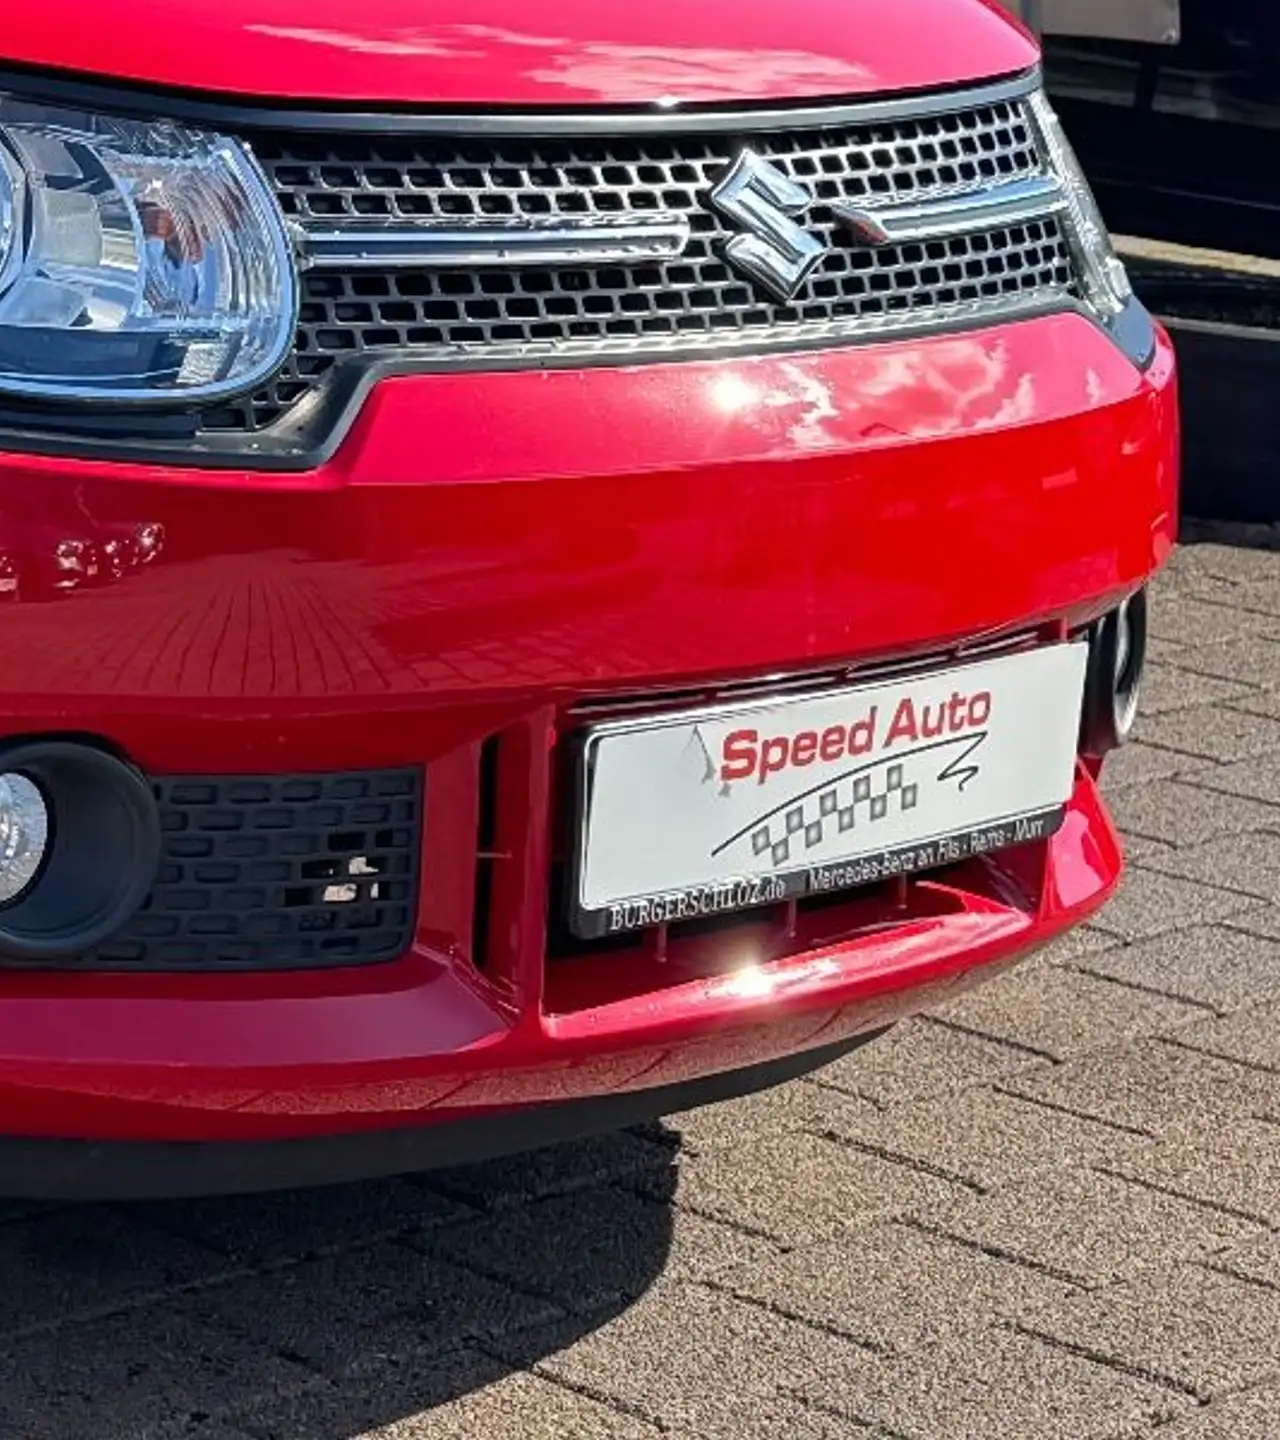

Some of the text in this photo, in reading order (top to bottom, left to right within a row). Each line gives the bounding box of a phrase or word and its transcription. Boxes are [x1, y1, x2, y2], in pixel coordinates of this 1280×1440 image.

[720, 690, 992, 784] Speed Auto
[809, 851, 915, 891] Mercedes-Benz
